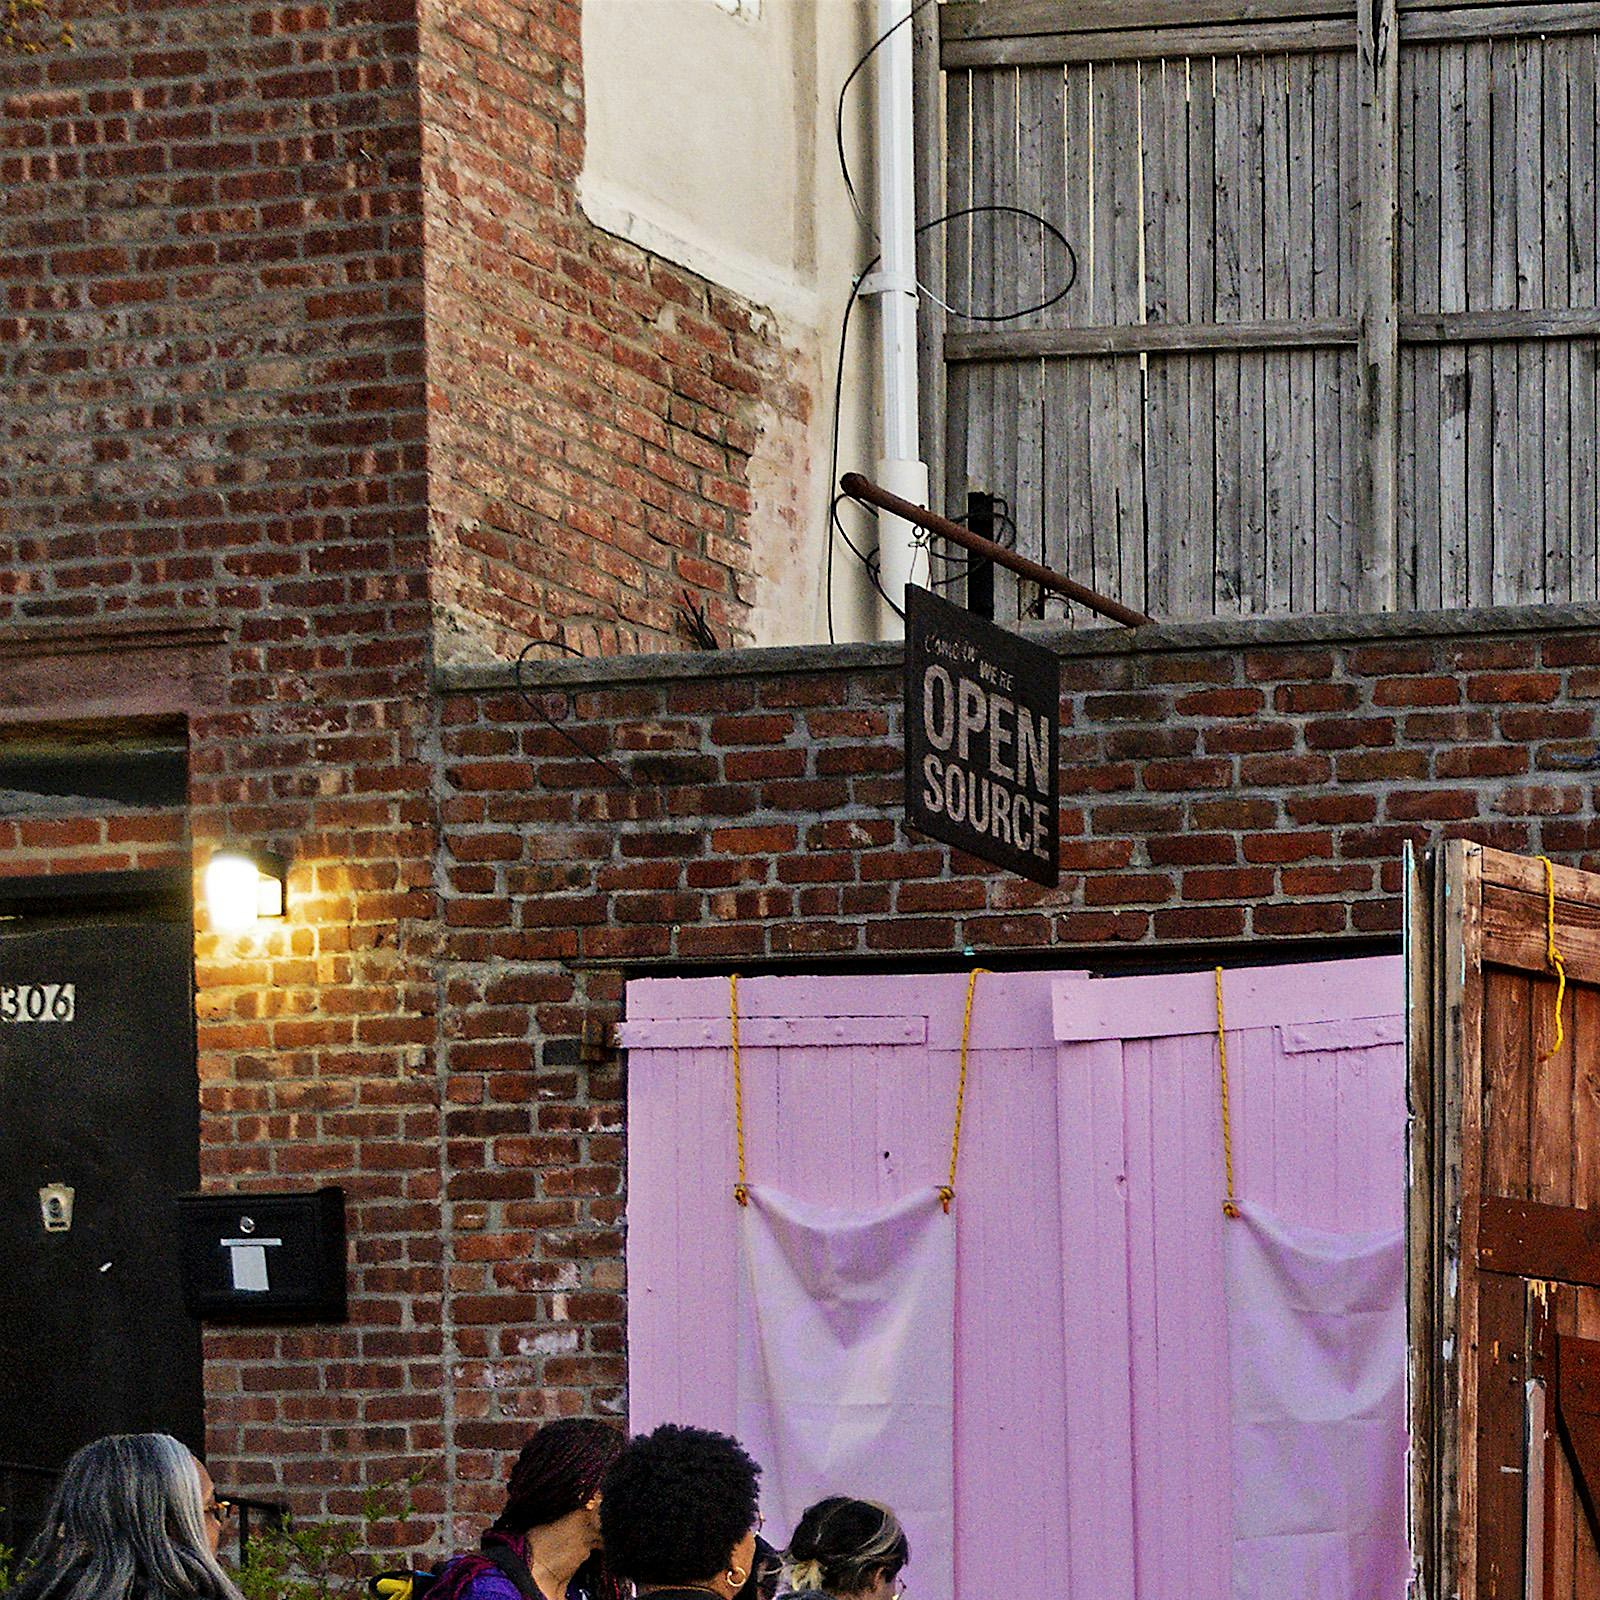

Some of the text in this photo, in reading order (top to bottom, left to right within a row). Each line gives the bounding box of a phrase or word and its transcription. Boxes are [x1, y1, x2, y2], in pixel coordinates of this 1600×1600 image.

[923, 664, 1049, 796] OPEN
[923, 752, 1049, 858] SOURCE
[0, 984, 71, 1021] 306
